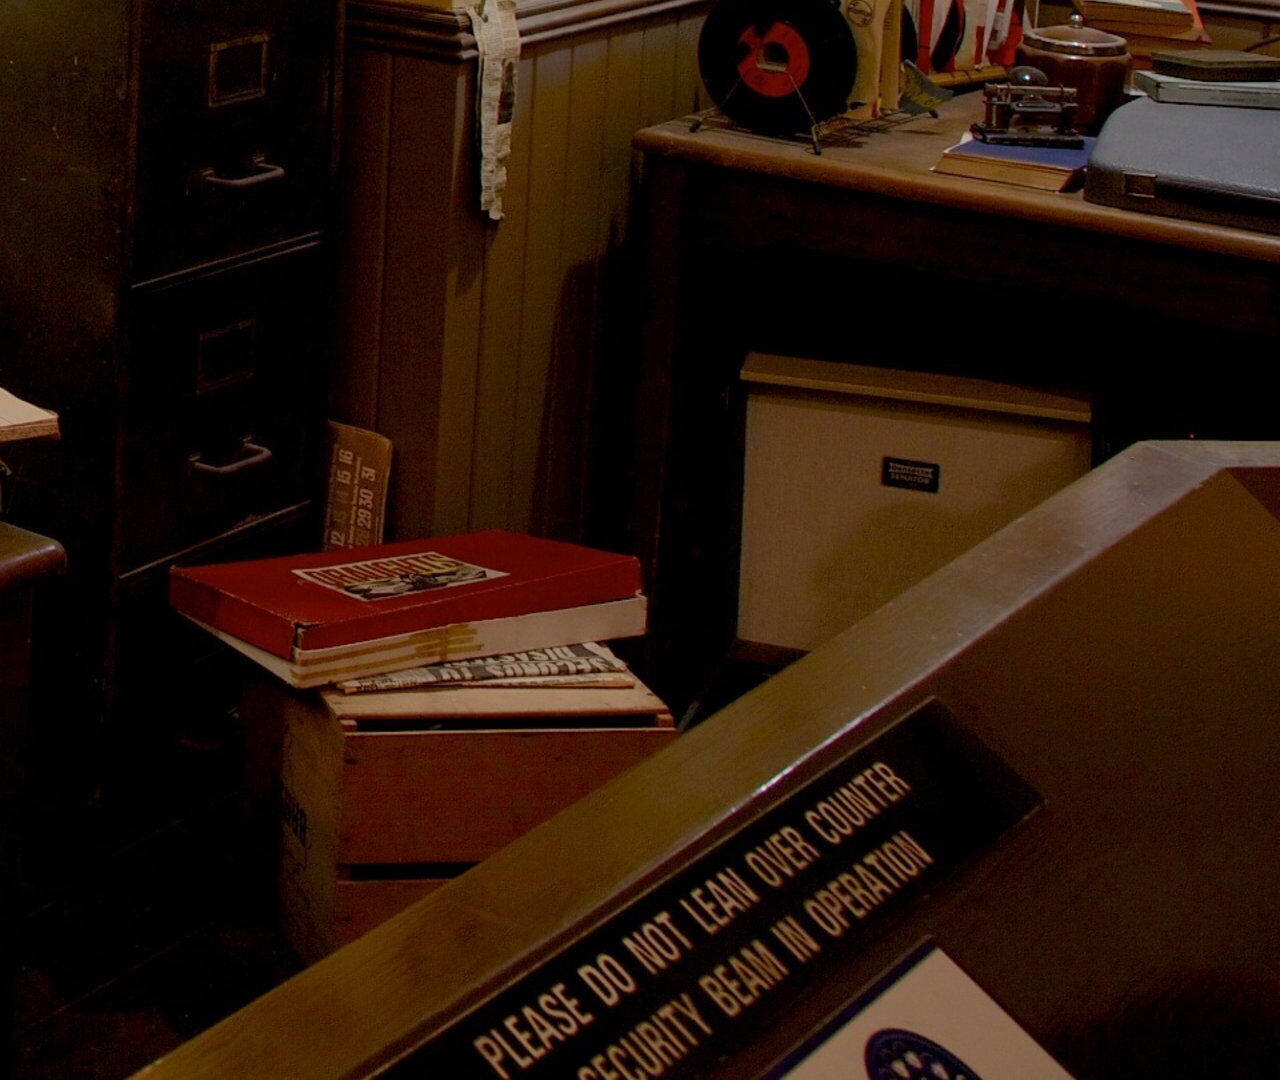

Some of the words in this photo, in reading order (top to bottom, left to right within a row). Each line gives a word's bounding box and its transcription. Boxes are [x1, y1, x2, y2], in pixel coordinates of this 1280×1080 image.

[474, 982, 594, 1080] PLEASE
[577, 953, 637, 1009] DO
[622, 911, 693, 976] NOT
[680, 868, 761, 936] LEAN
[746, 826, 820, 888] OVER
[805, 761, 911, 845] COUNTER
[699, 939, 791, 1018] BEAM
[771, 915, 821, 963] IN
[803, 830, 936, 939] OPERATION
